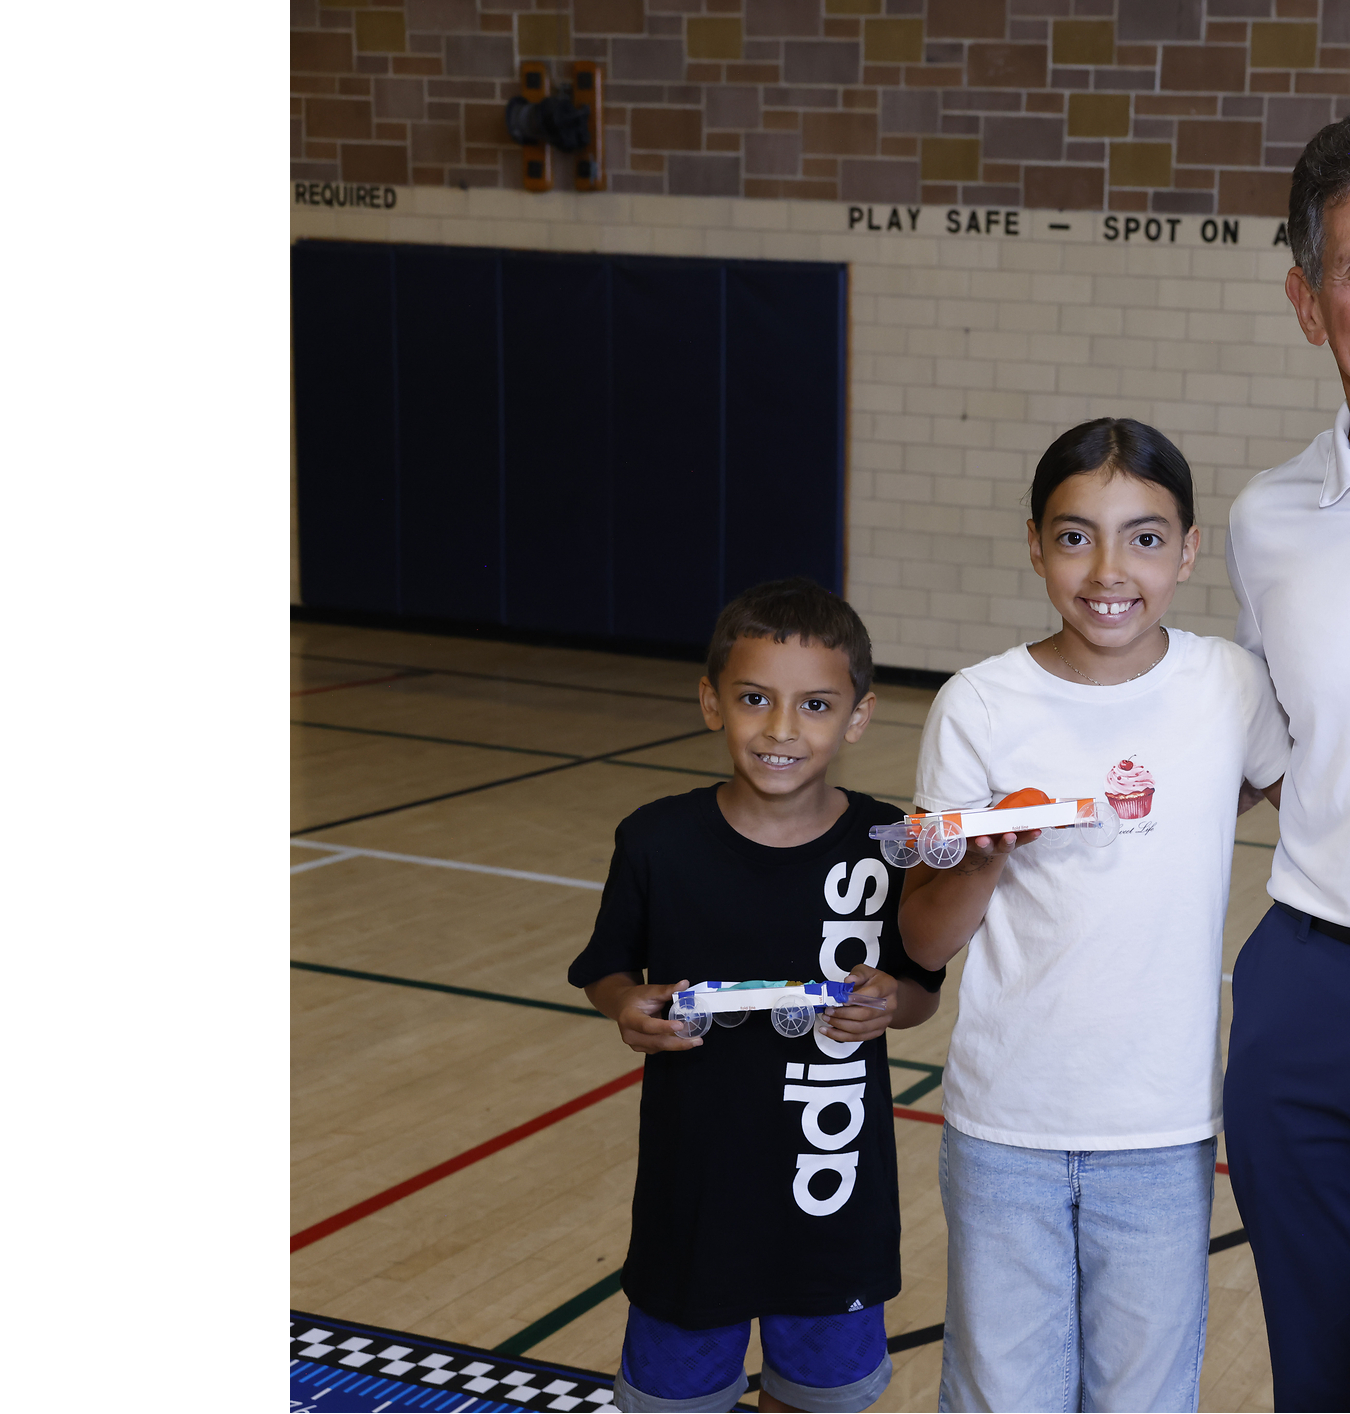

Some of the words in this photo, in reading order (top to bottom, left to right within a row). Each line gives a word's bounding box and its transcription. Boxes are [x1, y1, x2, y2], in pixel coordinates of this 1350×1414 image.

[295, 183, 397, 209] REQUIRED
[848, 206, 921, 231] PLAY
[946, 209, 1020, 235] SAFE
[1103, 216, 1181, 243] SPOT
[1201, 219, 1239, 244] ON
